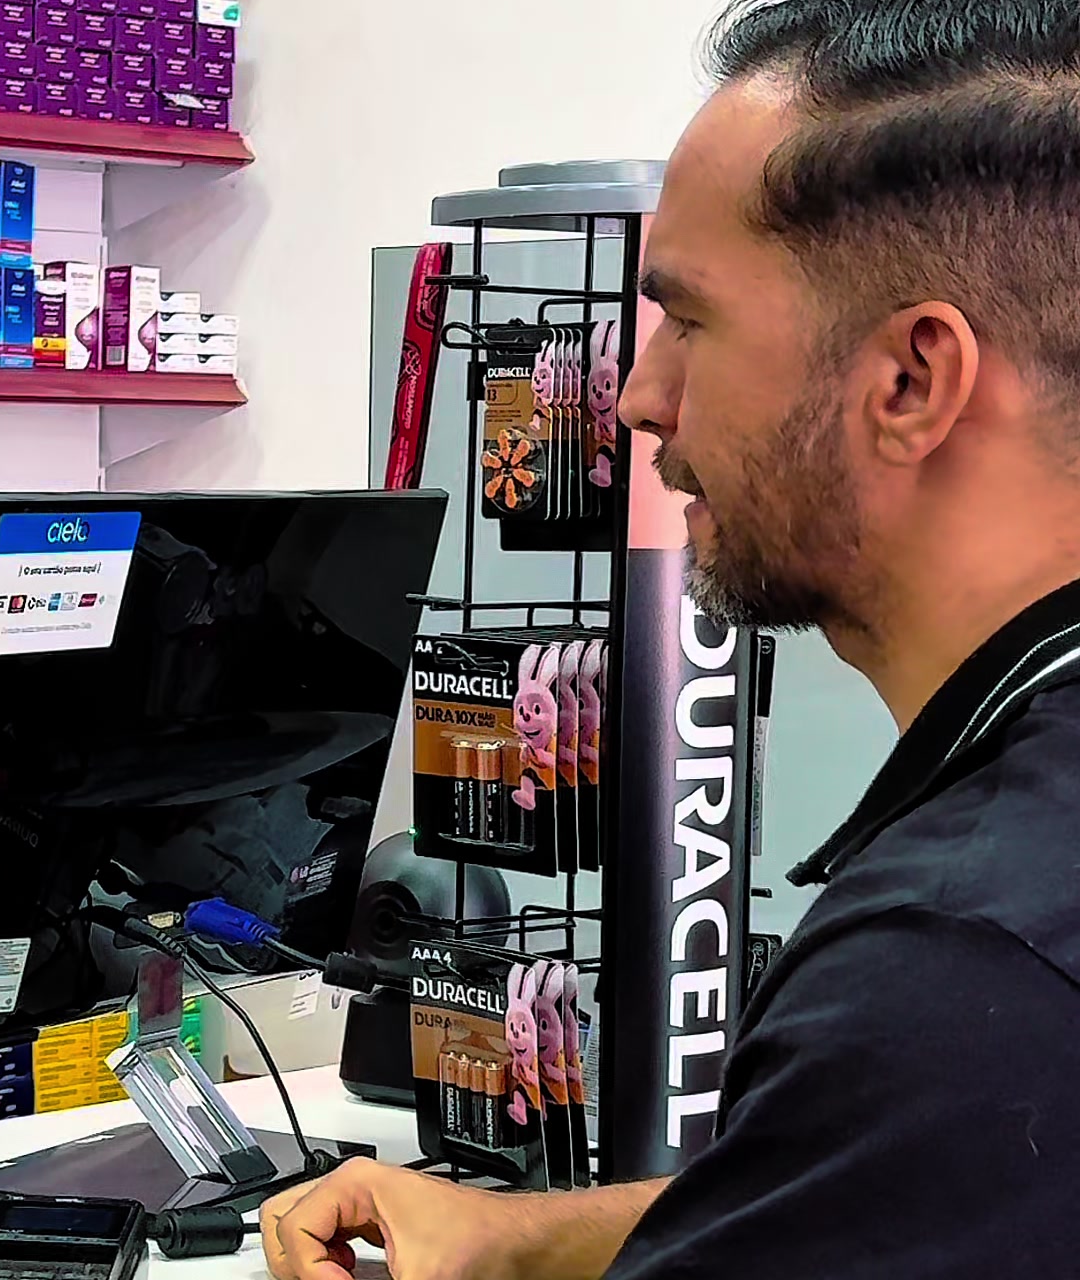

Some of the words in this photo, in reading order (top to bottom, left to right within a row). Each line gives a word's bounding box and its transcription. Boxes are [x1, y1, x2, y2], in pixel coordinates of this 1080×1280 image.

[46, 517, 91, 544] cielo
[414, 639, 433, 653] AA
[414, 670, 513, 700] DURACELL
[666, 594, 737, 1149] DURACELL
[410, 945, 440, 961] AAA
[411, 976, 505, 1015] DURACELL
